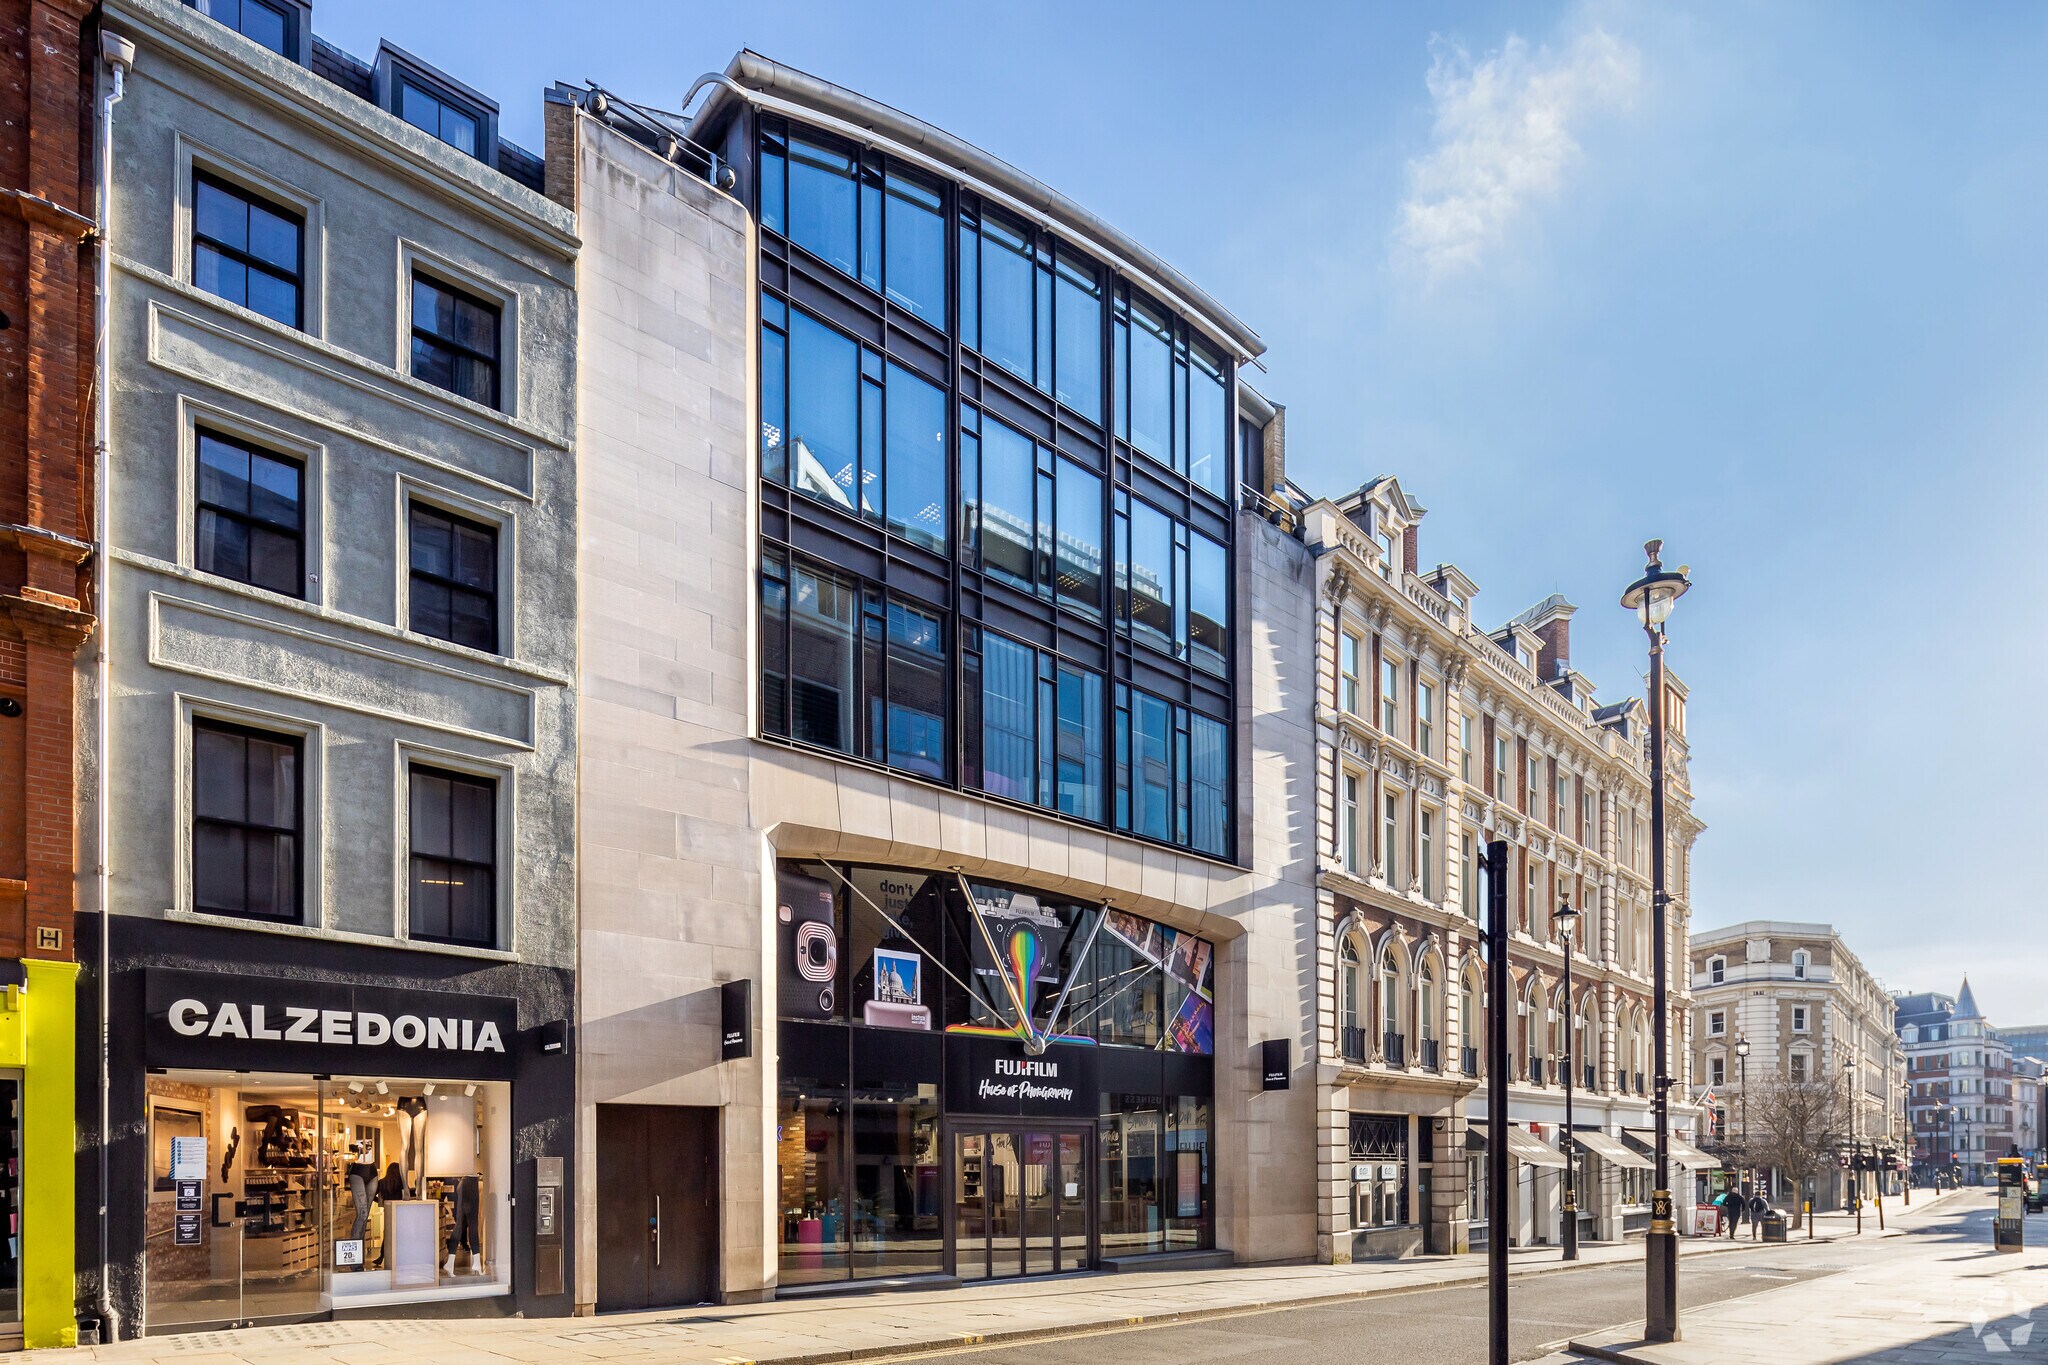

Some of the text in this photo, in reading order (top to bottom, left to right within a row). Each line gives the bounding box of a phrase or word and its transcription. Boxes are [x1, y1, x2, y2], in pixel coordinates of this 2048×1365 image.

[880, 879, 914, 897] don't
[883, 894, 911, 910] just
[40, 928, 59, 949] H
[168, 998, 506, 1053] CALZEDONIA
[995, 1059, 1058, 1078] FUJIFILM
